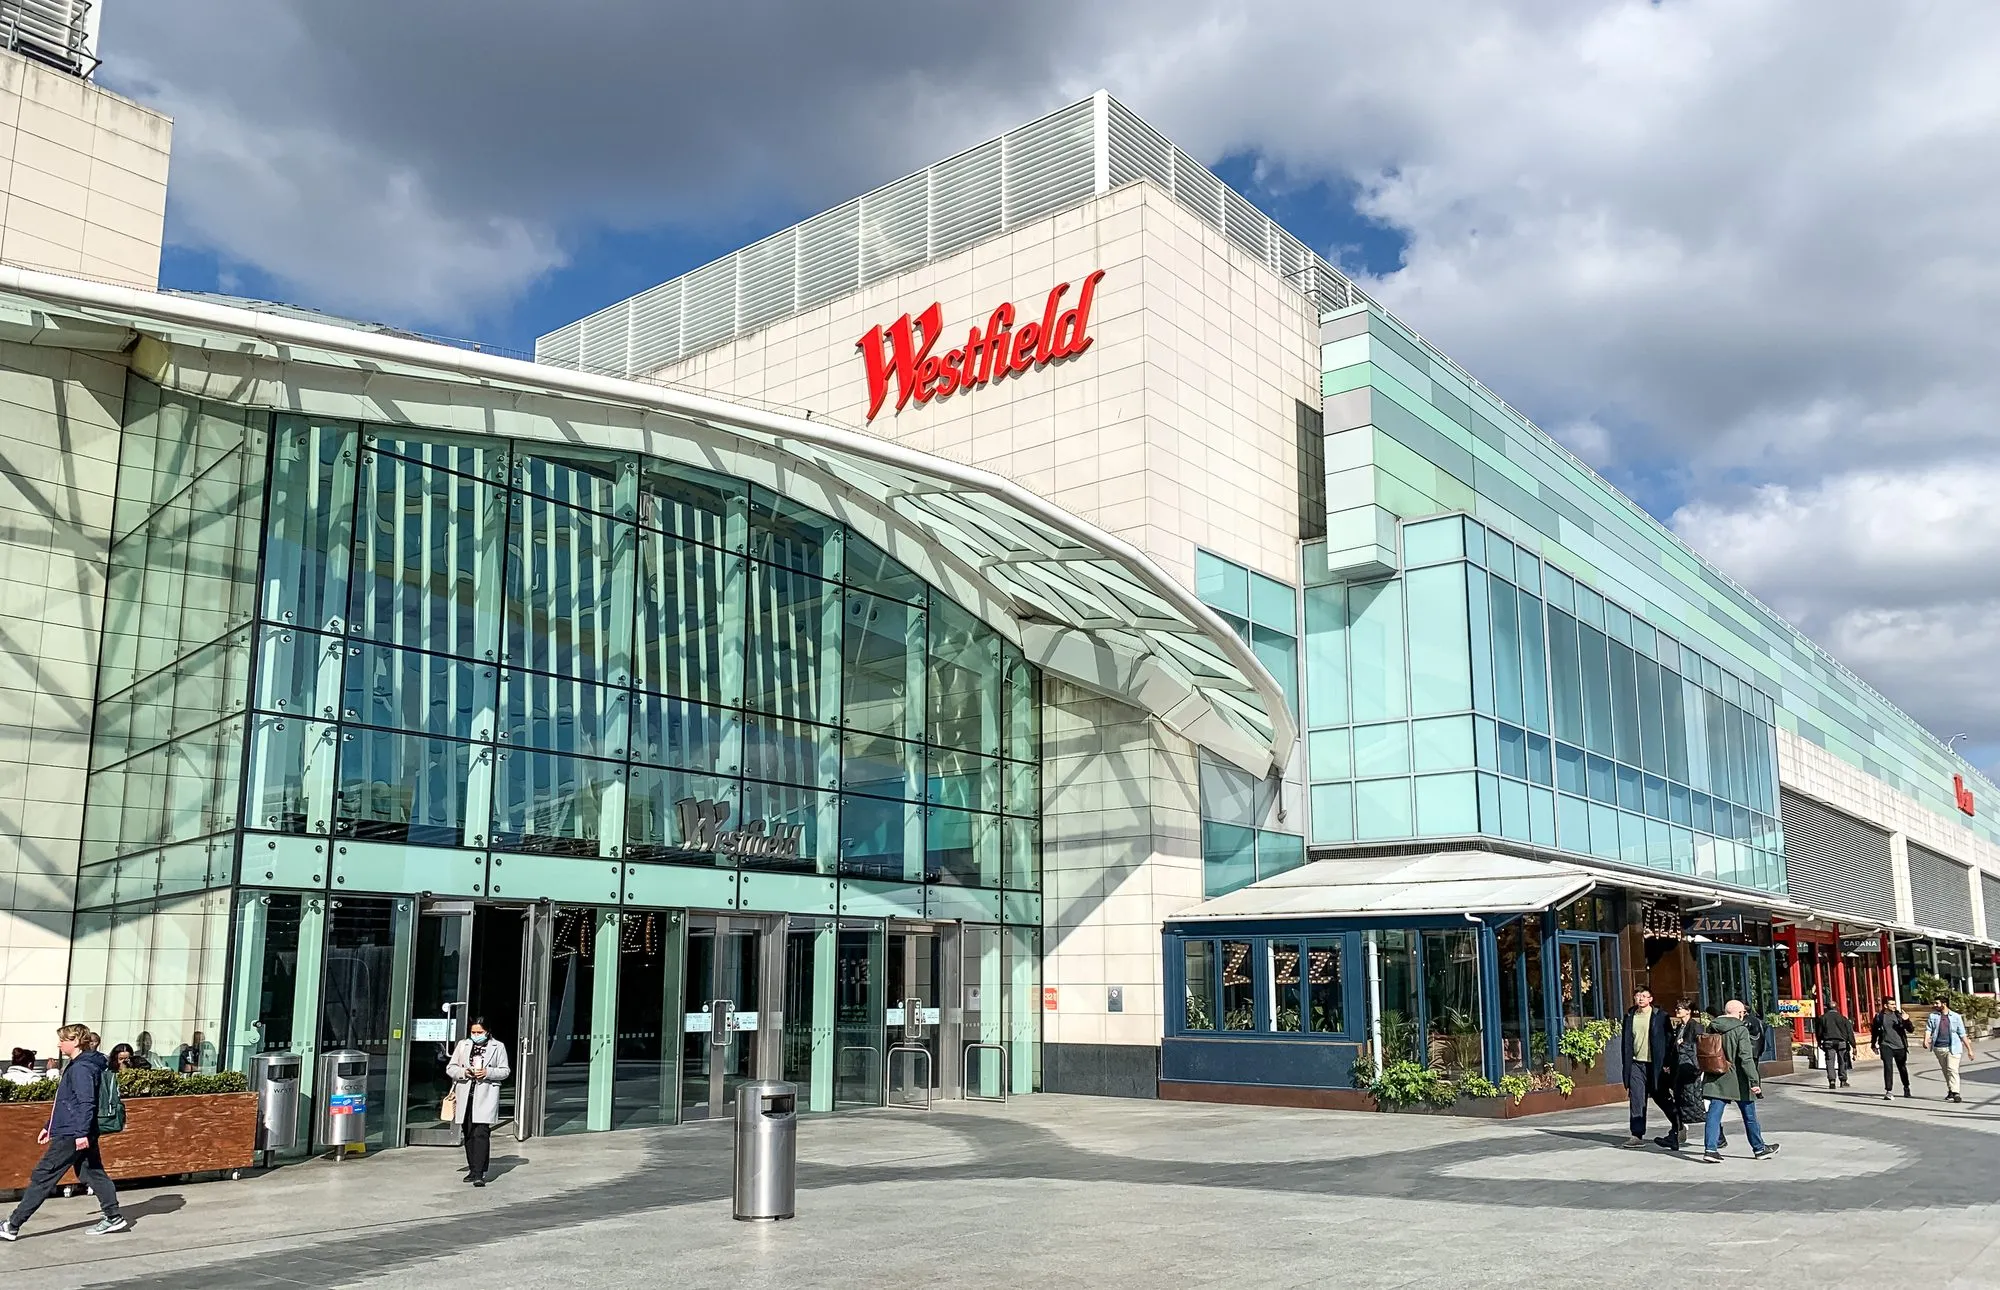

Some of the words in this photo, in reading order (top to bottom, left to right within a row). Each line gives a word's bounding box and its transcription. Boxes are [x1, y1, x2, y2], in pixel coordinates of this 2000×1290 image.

[855, 268, 1106, 421] Westfield
[674, 796, 805, 860] Westfield
[1693, 917, 1738, 931] Zizzi
